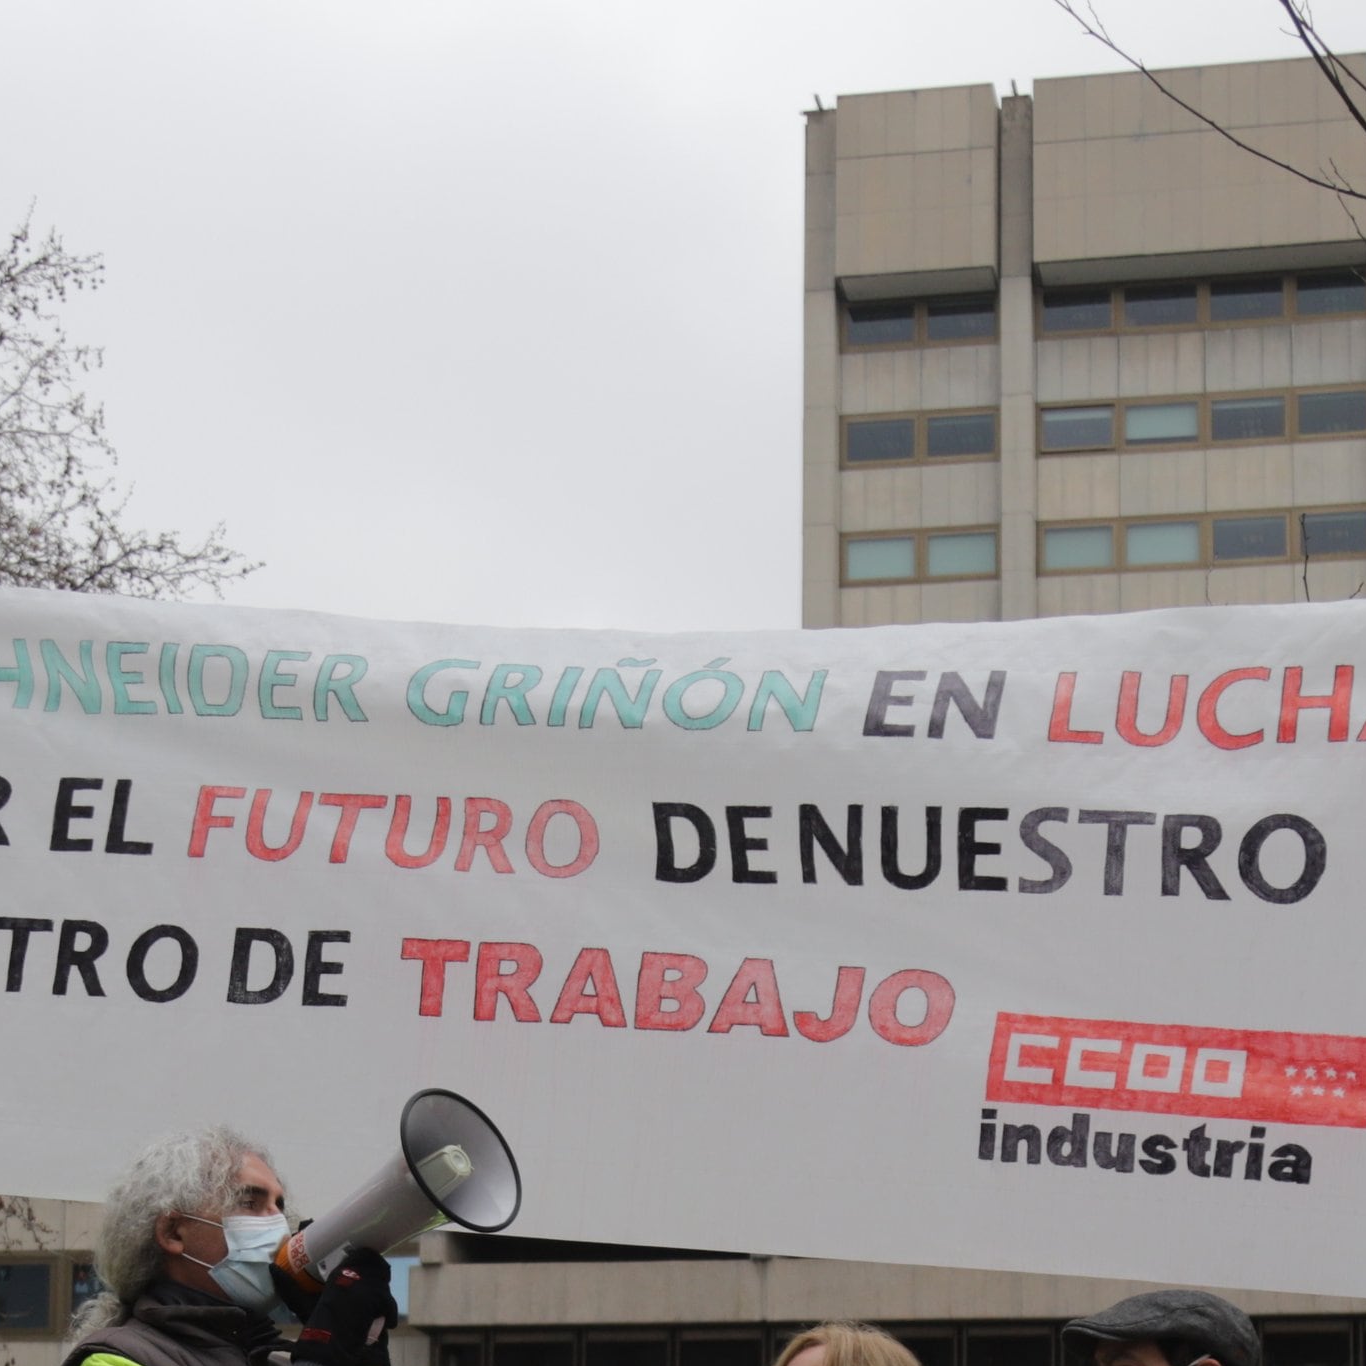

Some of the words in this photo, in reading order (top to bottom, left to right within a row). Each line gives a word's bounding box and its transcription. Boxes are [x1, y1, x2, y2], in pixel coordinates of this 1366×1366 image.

[407, 655, 828, 732] GRIÑÓN
[862, 669, 1008, 740] EN
[51, 777, 153, 855] EL
[187, 783, 601, 878] FUTURO
[227, 927, 352, 1007] DE
[401, 937, 956, 1047] TRABAJO
[1002, 1031, 1248, 1099] CCOO
[977, 1107, 1314, 1185] industria
